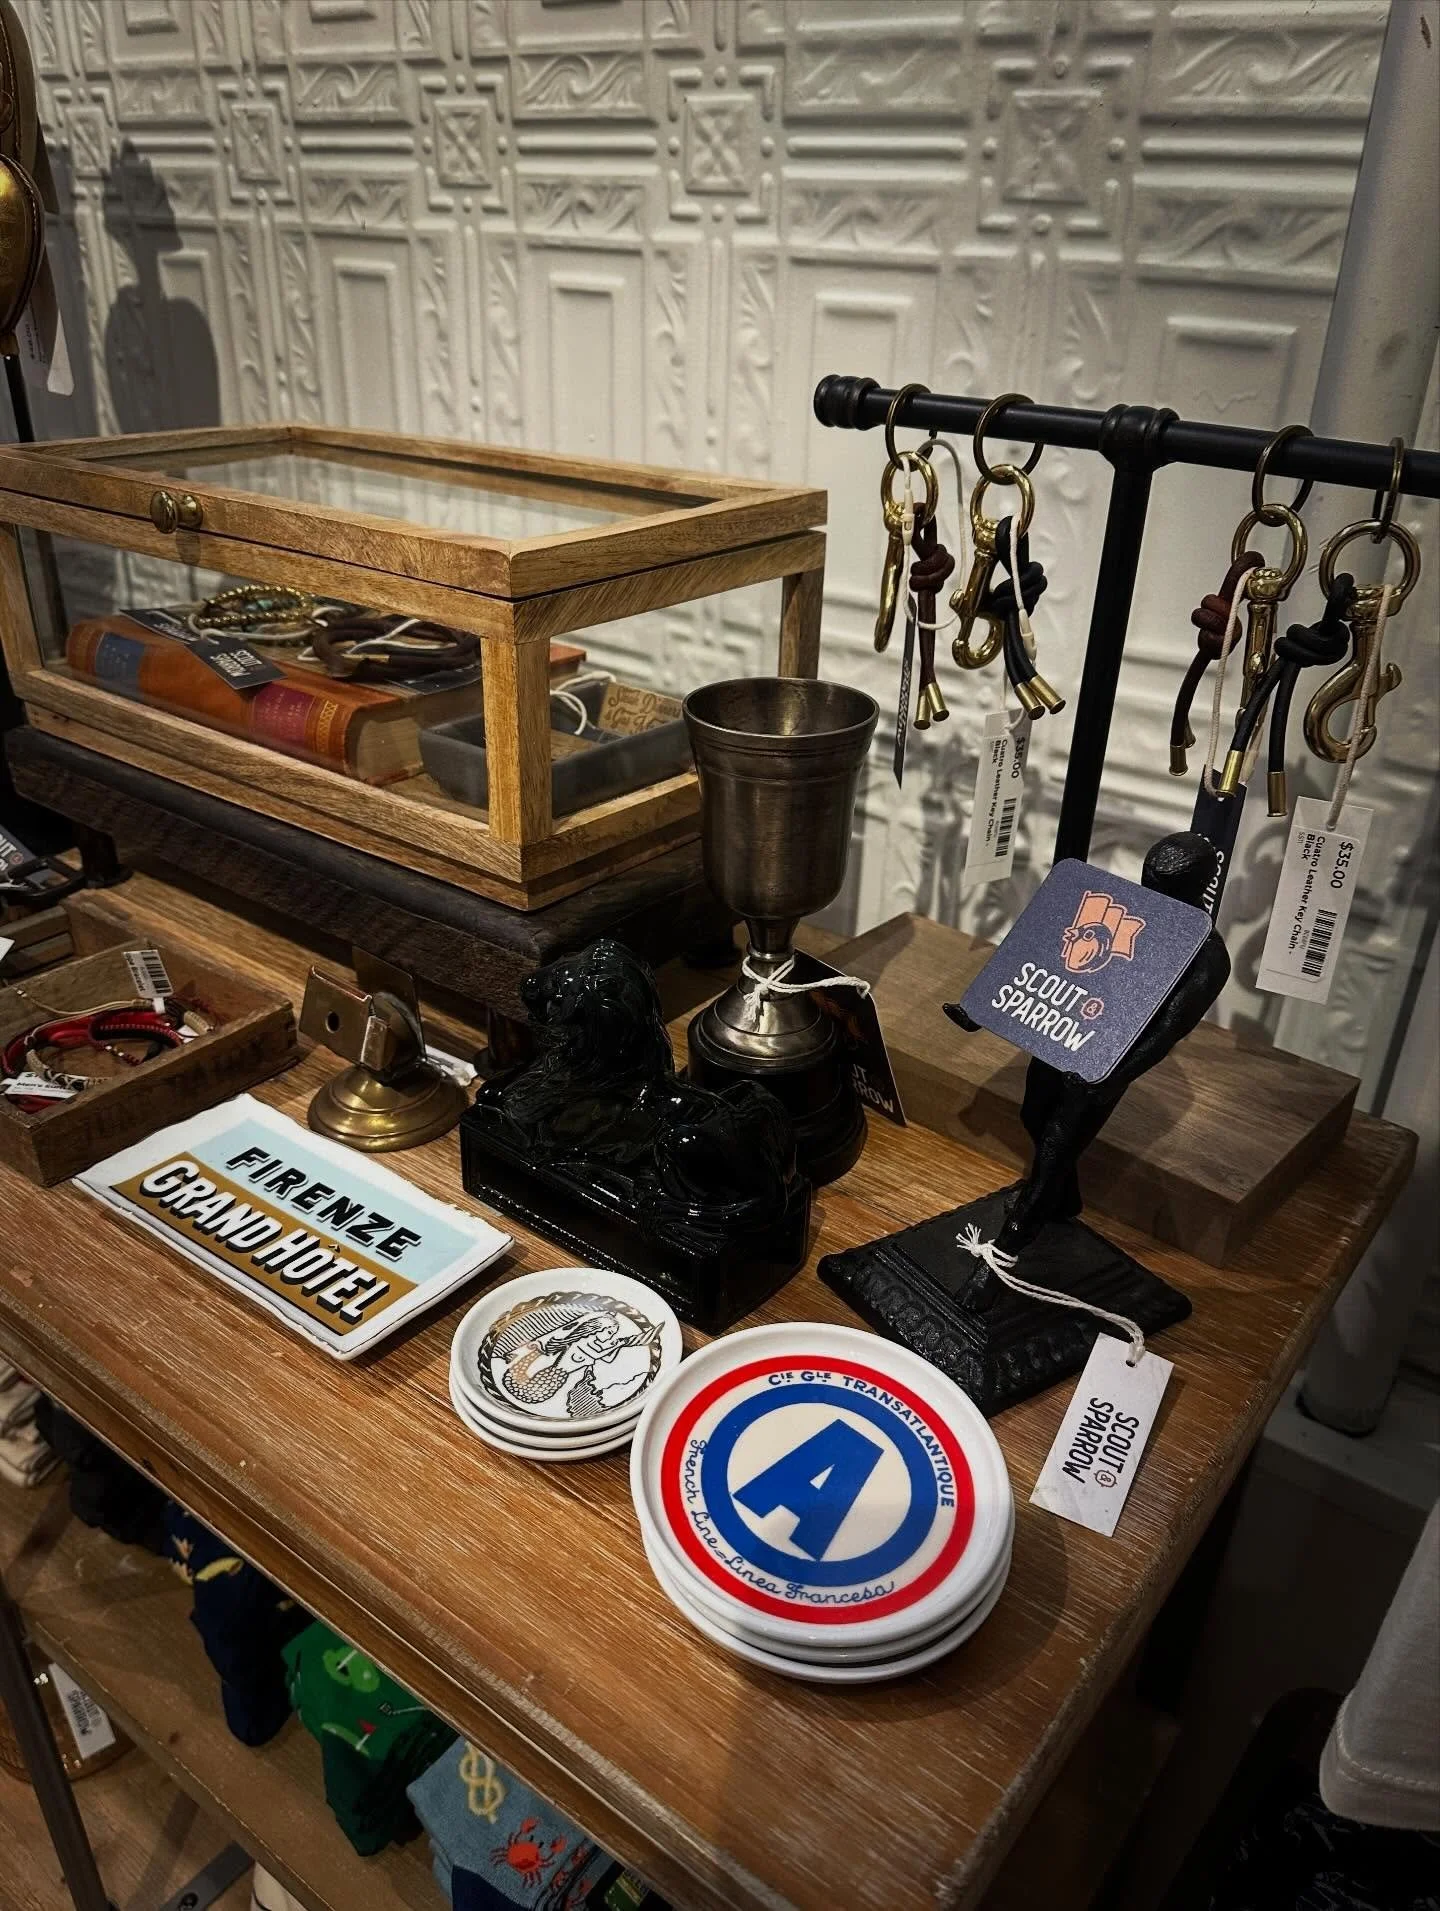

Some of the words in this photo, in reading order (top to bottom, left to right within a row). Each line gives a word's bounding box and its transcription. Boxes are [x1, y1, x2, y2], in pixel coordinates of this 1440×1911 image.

[992, 739, 1001, 764] Black
[998, 739, 1008, 769] Cuatro
[1011, 736, 1026, 779] $35.00
[992, 770, 1003, 800] Leather
[985, 818, 995, 842] Chain
[990, 801, 998, 818] Key
[1301, 833, 1316, 860] Black
[1311, 837, 1325, 866] Cuatro
[1330, 841, 1354, 889] $35.00
[1302, 870, 1317, 904] Leather
[1288, 923, 1303, 949] Chain
[1295, 905, 1307, 924] Key
[1013, 962, 1089, 1012] SCOUT
[991, 984, 1096, 1052] SPARROW
[226, 1146, 423, 1262] FIRENZE
[140, 1160, 284, 1255] GRAND
[250, 1228, 391, 1324] HÔTEL
[843, 1376, 955, 1508] TRANSATLANTIQUE
[1062, 1397, 1115, 1484] SPARROW
[1098, 1412, 1140, 1474] SCOUT
[732, 1418, 885, 1562] A
[685, 1439, 707, 1504] French
[785, 1581, 895, 1604] Francesa
